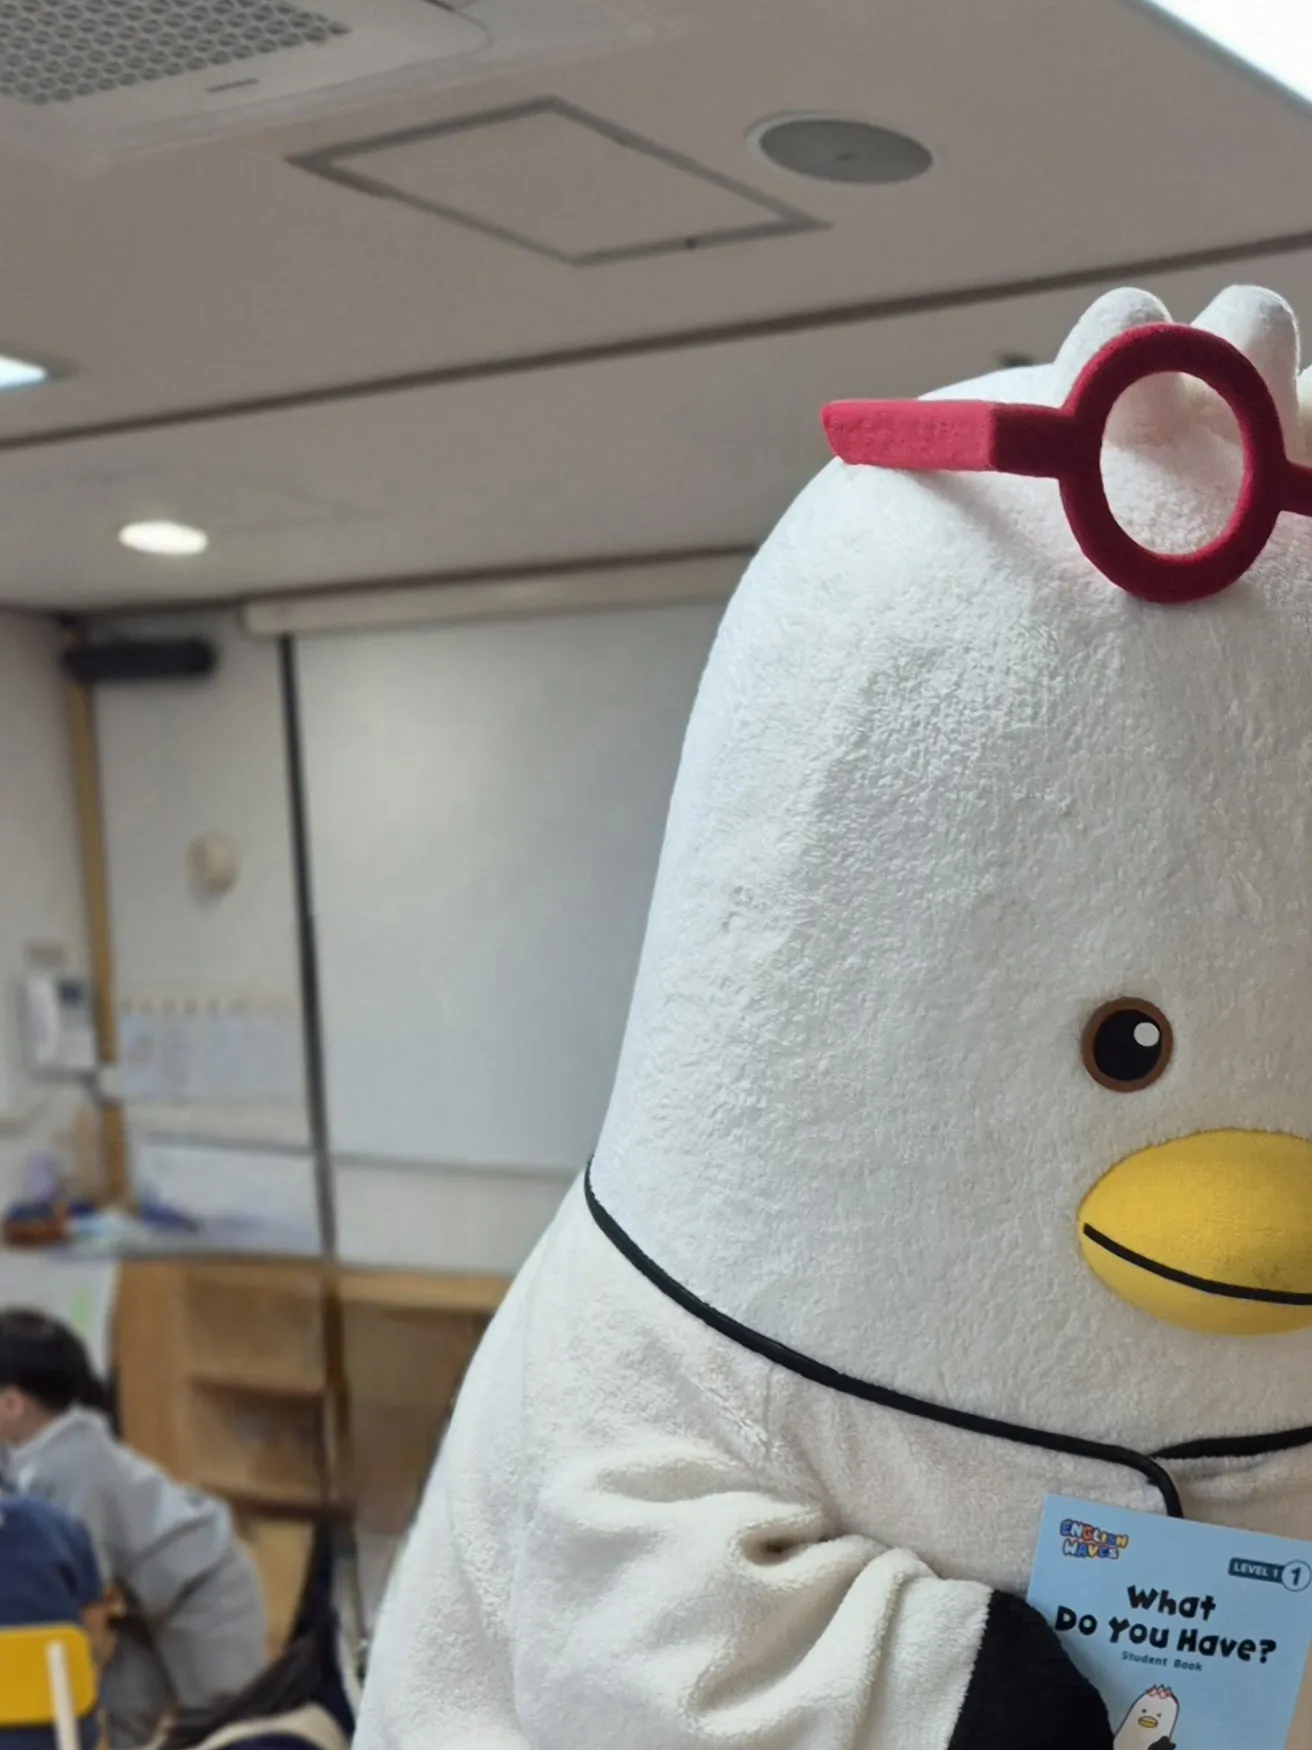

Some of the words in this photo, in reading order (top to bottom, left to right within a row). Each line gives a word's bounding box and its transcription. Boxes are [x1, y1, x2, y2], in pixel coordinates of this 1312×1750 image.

[1060, 1519, 1129, 1549] ENGLISH
[1062, 1540, 1119, 1559] WAVES
[1234, 1561, 1270, 1578] LEVEL
[1273, 1568, 1280, 1578] 1
[1290, 1567, 1302, 1586] 1
[1127, 1585, 1216, 1621] What
[1055, 1606, 1098, 1635] Do
[1108, 1616, 1169, 1649] You
[1177, 1628, 1277, 1664] Have?
[1121, 1651, 1168, 1668] Student
[1173, 1658, 1203, 1672] Book
